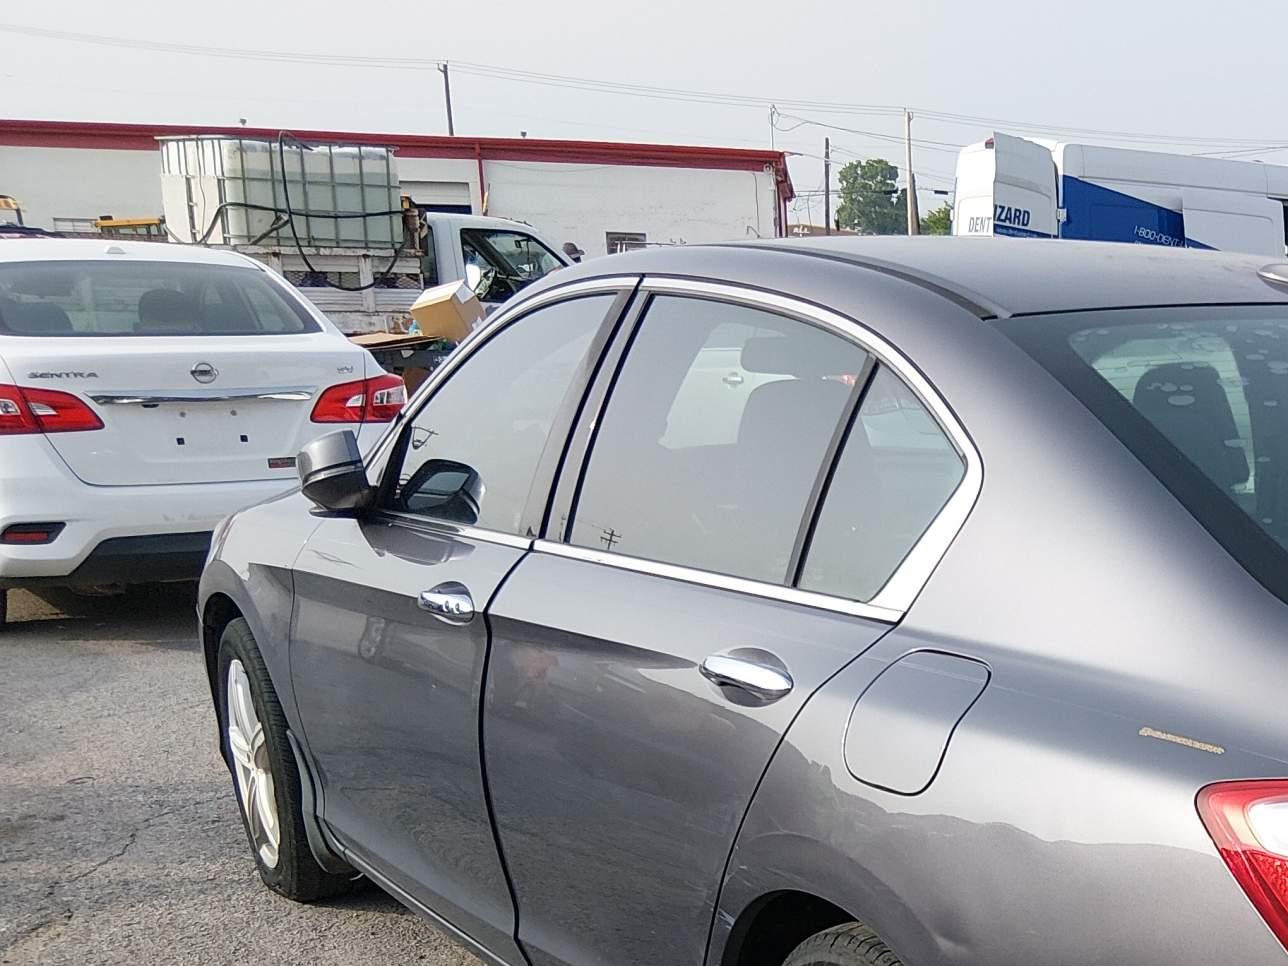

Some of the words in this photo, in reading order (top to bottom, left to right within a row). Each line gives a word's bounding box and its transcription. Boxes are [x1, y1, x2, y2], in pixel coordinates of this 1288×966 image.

[968, 217, 992, 233] DENT
[993, 203, 1031, 226] IZARD
[27, 371, 99, 379] SENTRA
